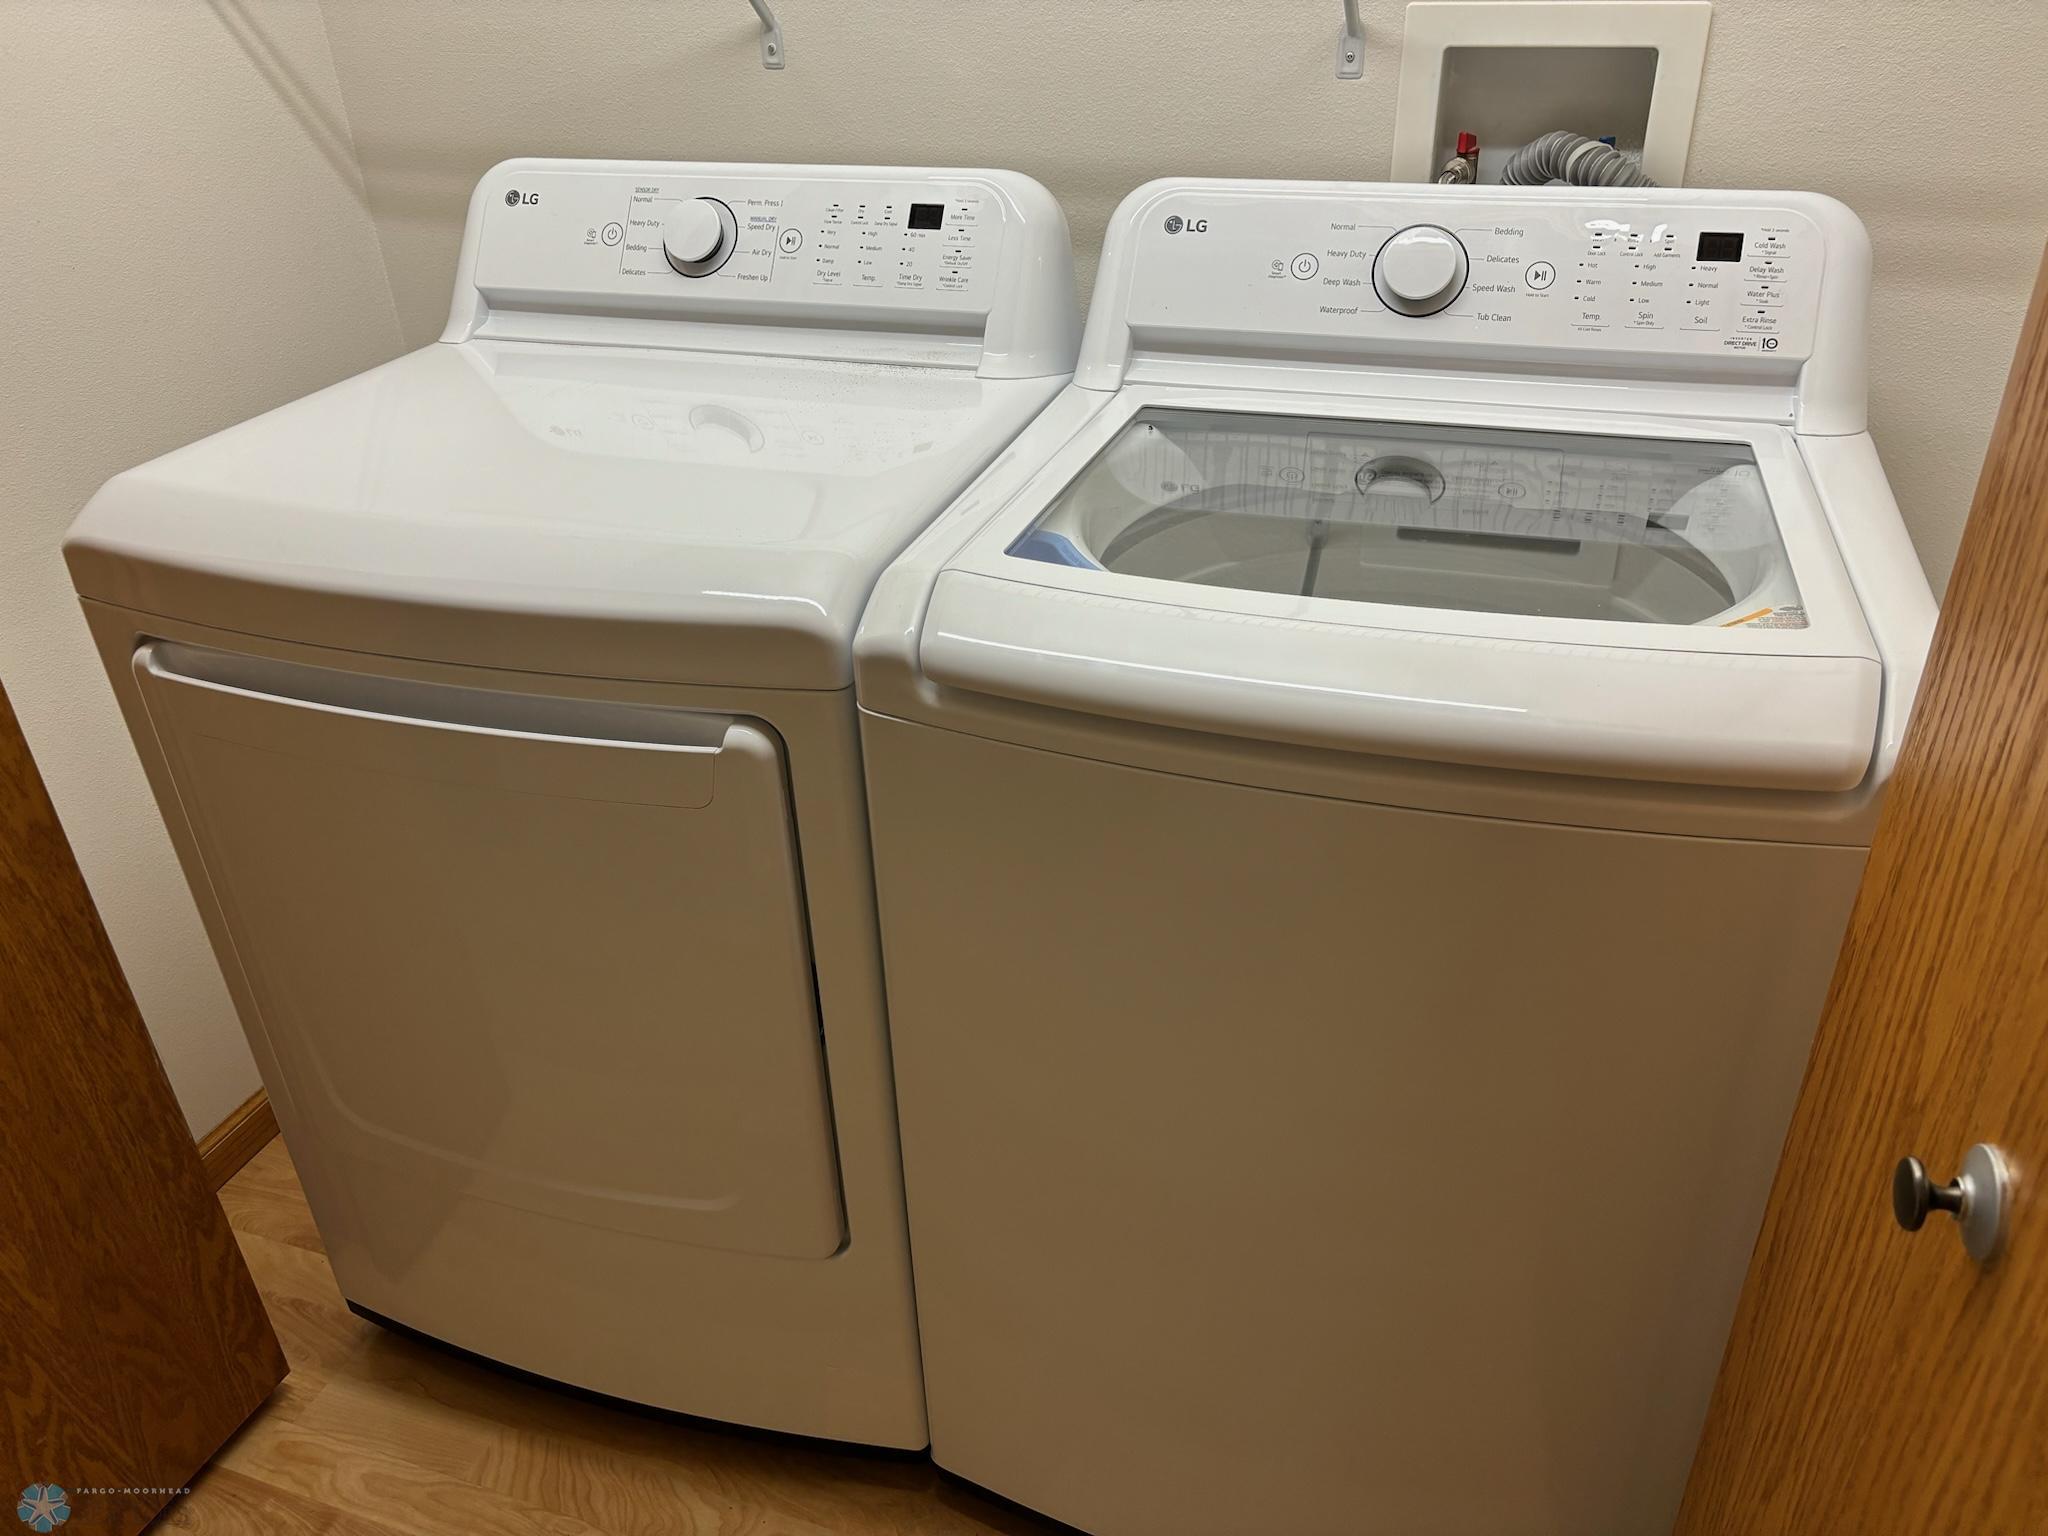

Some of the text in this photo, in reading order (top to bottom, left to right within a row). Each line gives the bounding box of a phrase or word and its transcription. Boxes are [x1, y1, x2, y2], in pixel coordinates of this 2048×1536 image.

[630, 219, 660, 228] Heavy Duty
[747, 223, 776, 232] Speed Dry
[1494, 227, 1524, 237] Bedding
[626, 244, 647, 252] Bedding
[762, 249, 772, 258] Dry
[1327, 250, 1366, 260] Heavy Duty
[1486, 255, 1520, 263] Delicates
[622, 268, 646, 276] Delicates
[817, 270, 826, 278] Dry
[1749, 266, 1766, 274] Delay
[737, 273, 768, 282] Freshen Up
[913, 274, 922, 282] Dry
[1323, 278, 1340, 287] Deep
[1472, 284, 1516, 293] Speed Wash
[1319, 306, 1359, 315] Waterproof
[1477, 313, 1512, 322] Tub Clean
[1638, 312, 1654, 320] Spin
[1694, 316, 1708, 324] Soil
